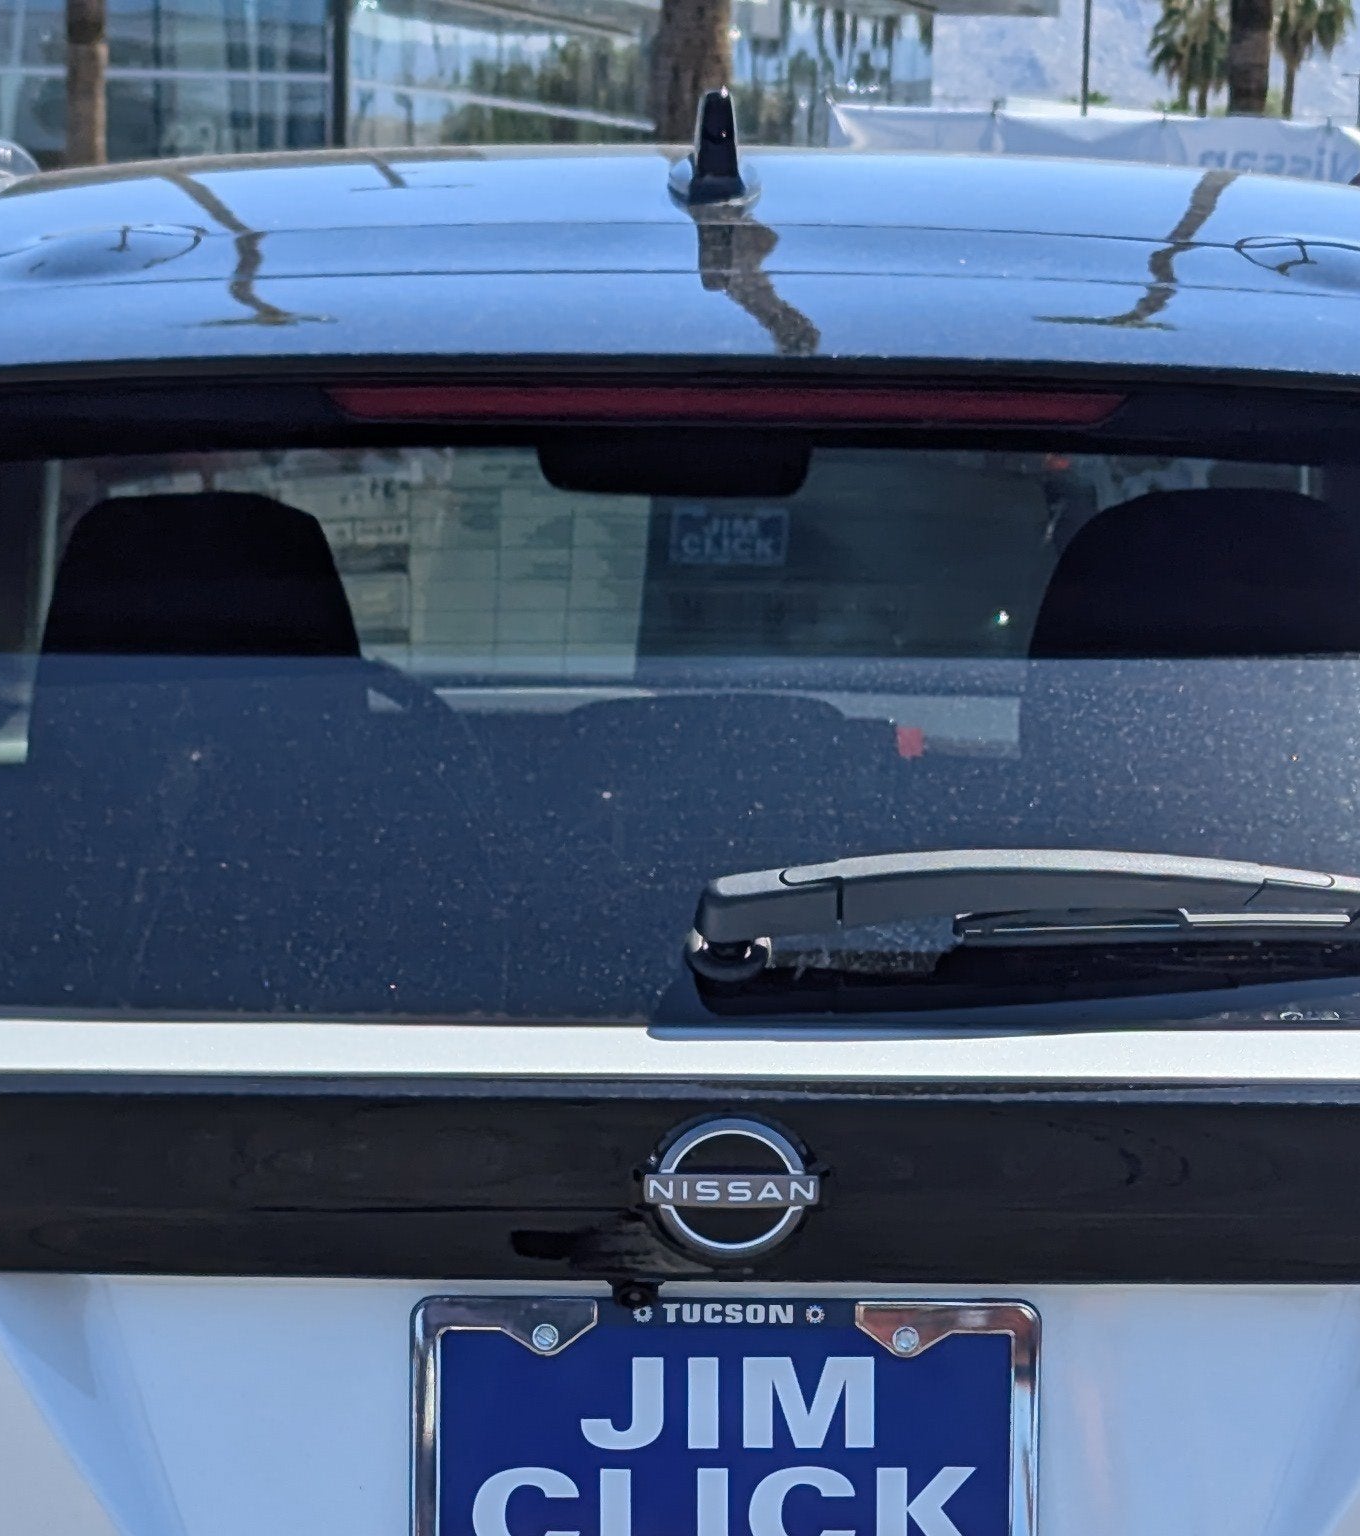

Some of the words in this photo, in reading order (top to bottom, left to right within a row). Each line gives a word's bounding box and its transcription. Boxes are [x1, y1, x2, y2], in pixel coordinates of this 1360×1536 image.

[703, 518, 759, 536] JIM
[648, 1179, 816, 1202] NISSAN
[662, 1303, 794, 1324] TUCSON
[580, 1356, 876, 1451] JIM
